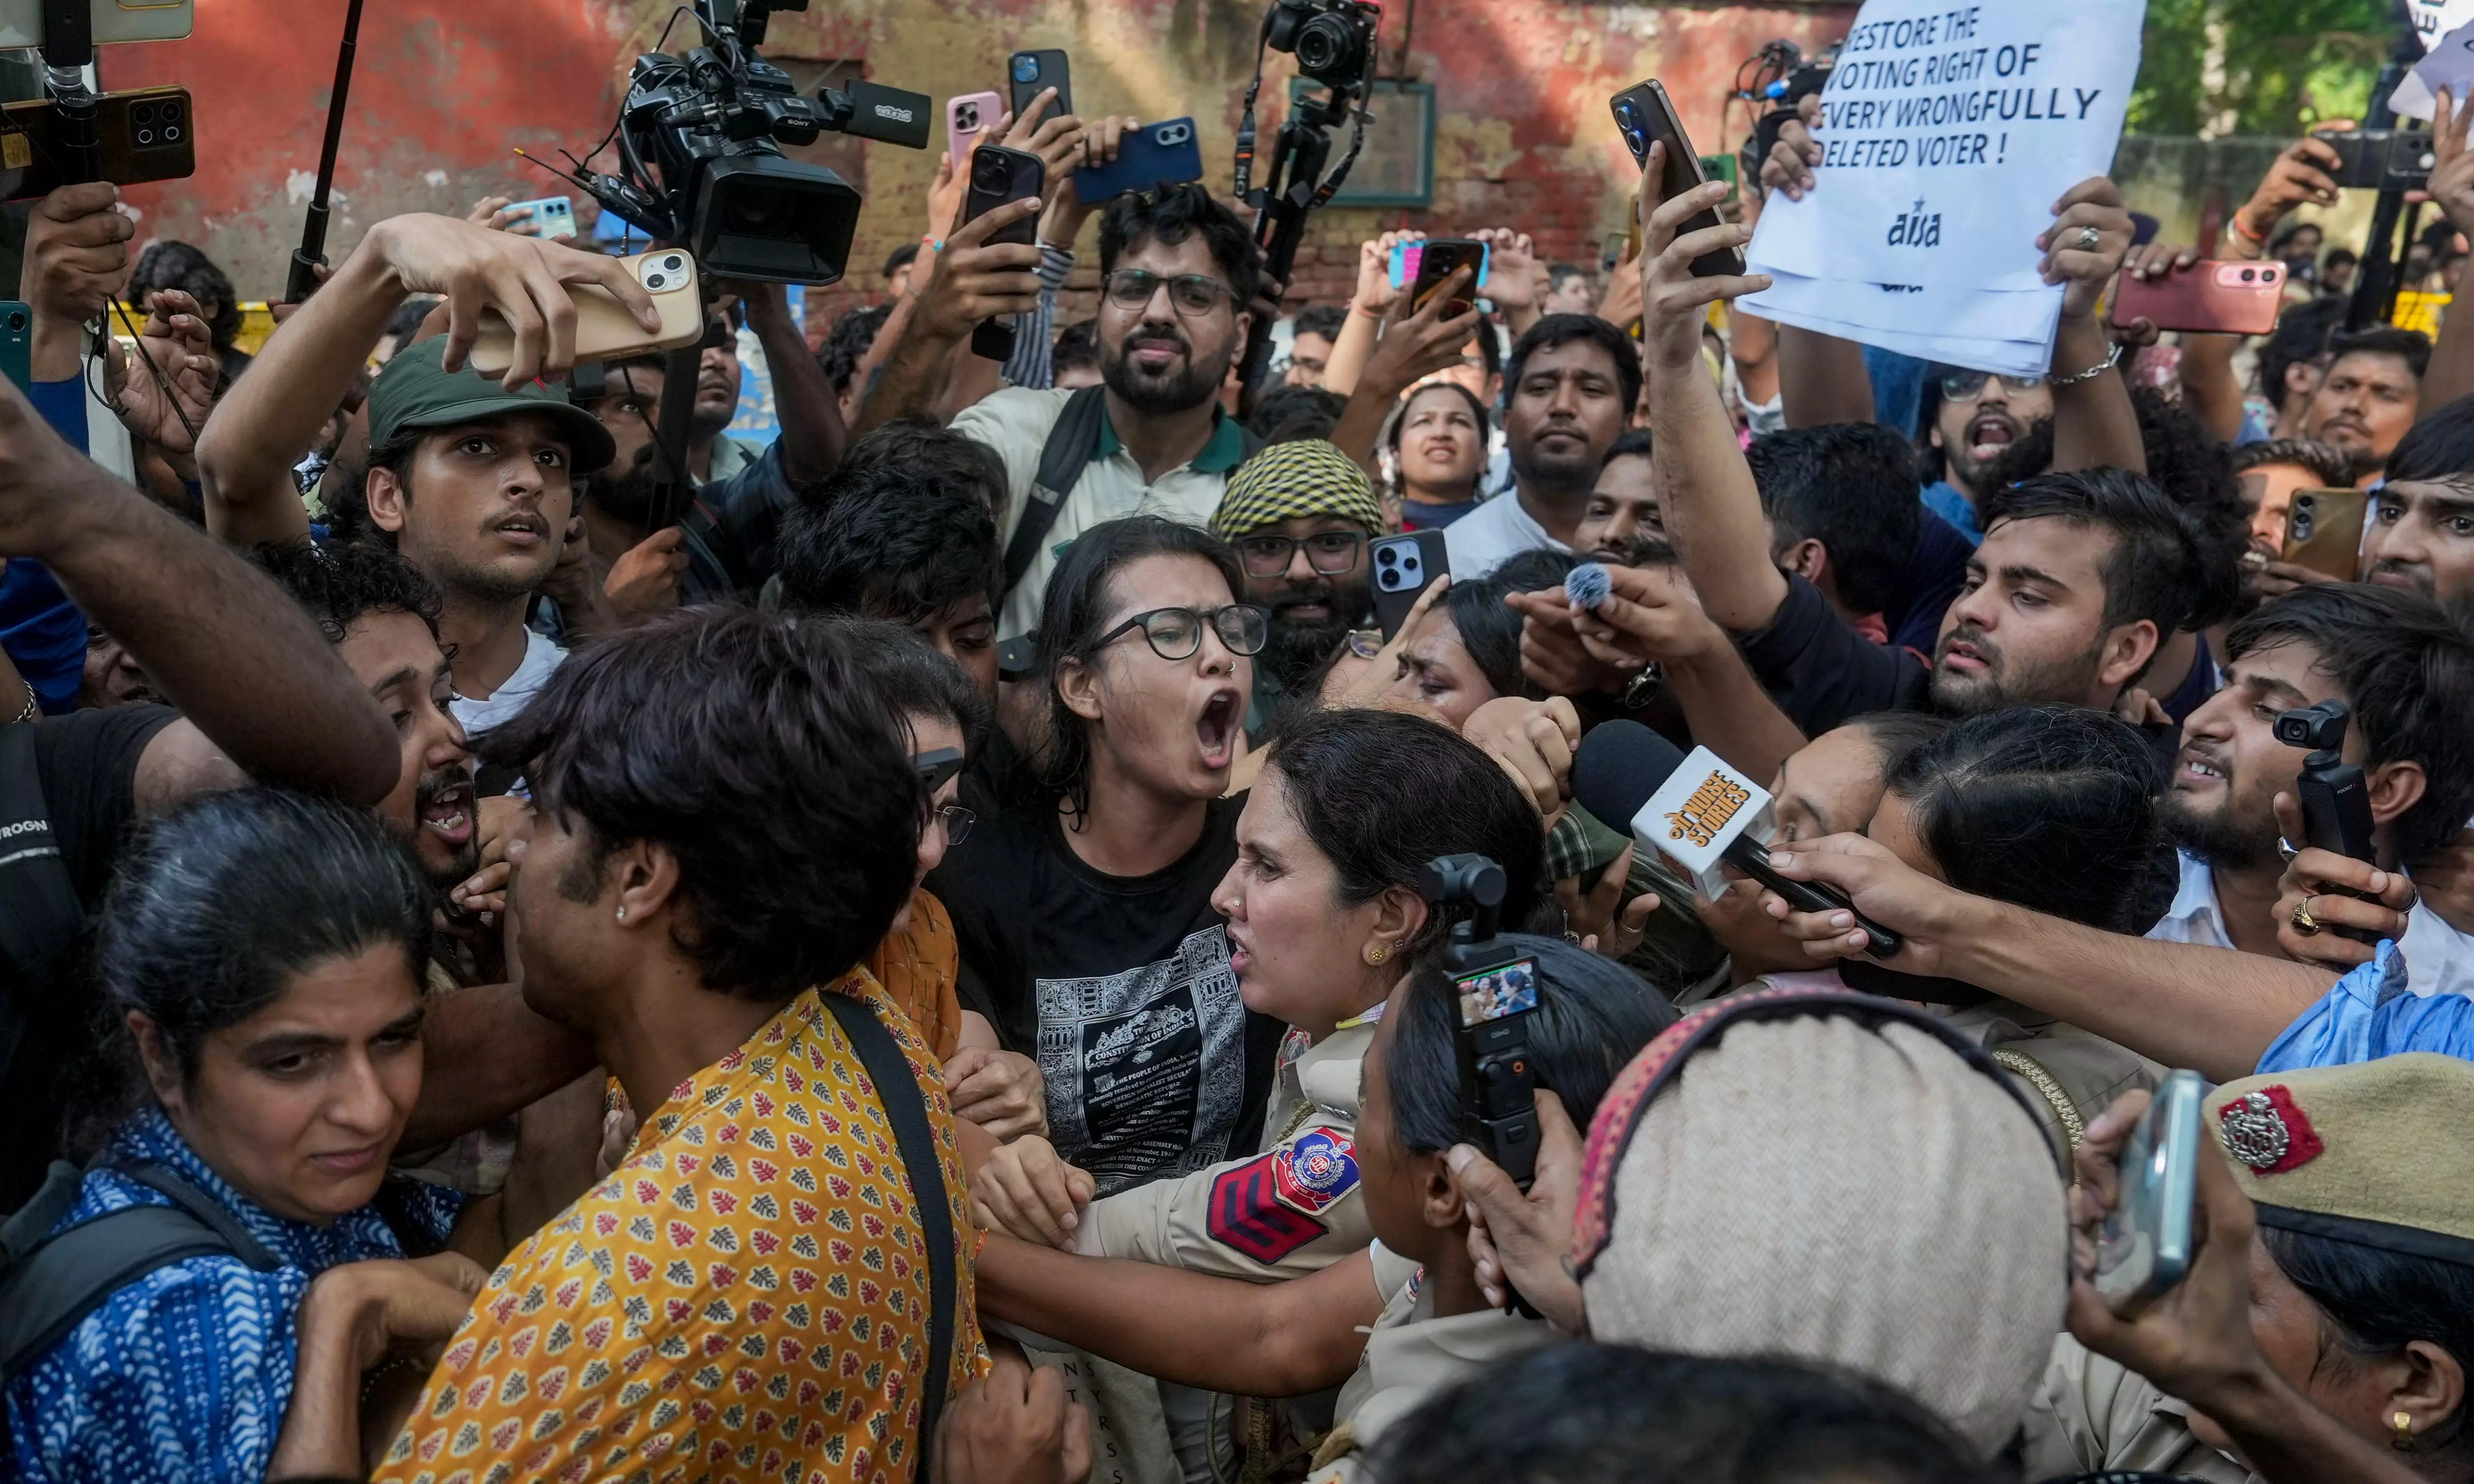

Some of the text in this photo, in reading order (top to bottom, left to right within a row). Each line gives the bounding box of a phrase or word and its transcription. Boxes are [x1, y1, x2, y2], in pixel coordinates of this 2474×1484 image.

[1944, 6, 1980, 42] THE
[1923, 47, 1989, 86] RIGHT
[1996, 43, 2042, 77] OF
[1895, 88, 2101, 127] WRONGFULLY
[1918, 133, 1988, 166] VOTER
[1681, 769, 1734, 820] NOISE
[2337, 784, 2352, 795] POCKET
[0, 820, 48, 840] ROGN
[1686, 783, 1751, 848] STORIES
[1095, 1020, 1185, 1060] CONSTITION OF INDIA
[1114, 1081, 1139, 1094] resolved
[1128, 1067, 1152, 1081] PEOPLE
[1152, 1064, 1161, 1072] OF
[1101, 1091, 1136, 1108] SOVEREIGN
[1136, 1077, 1166, 1094] SOCIALIST
[1115, 1090, 1155, 1109] DEMOCRATIC
[1136, 1156, 1157, 1164] ENACT
[1142, 1140, 1173, 1149] ASSEMBLY
